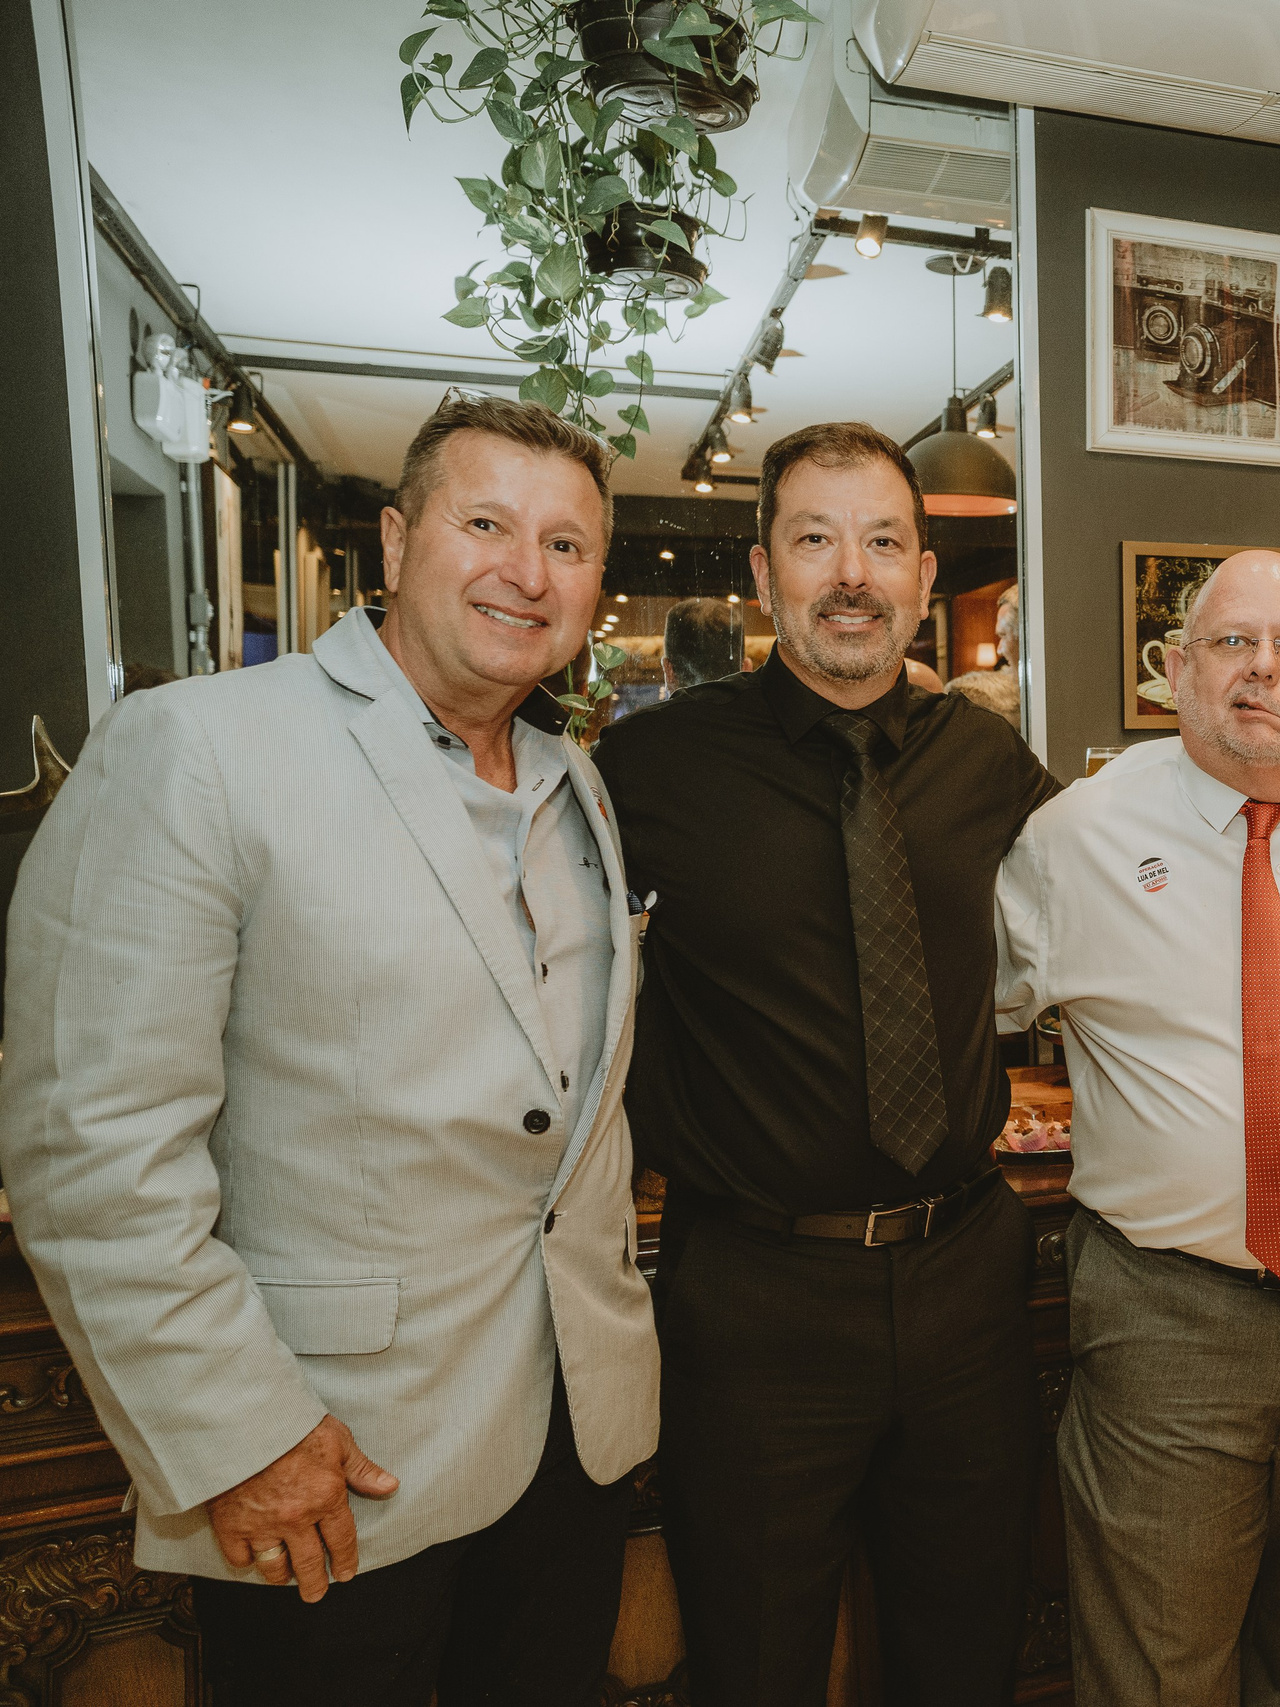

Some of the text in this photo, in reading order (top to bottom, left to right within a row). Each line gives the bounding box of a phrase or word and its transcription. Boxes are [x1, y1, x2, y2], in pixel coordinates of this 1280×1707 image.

[1137, 866, 1169, 883] LUA DE MEL
[1138, 862, 1164, 873] OPERAÇÃO
